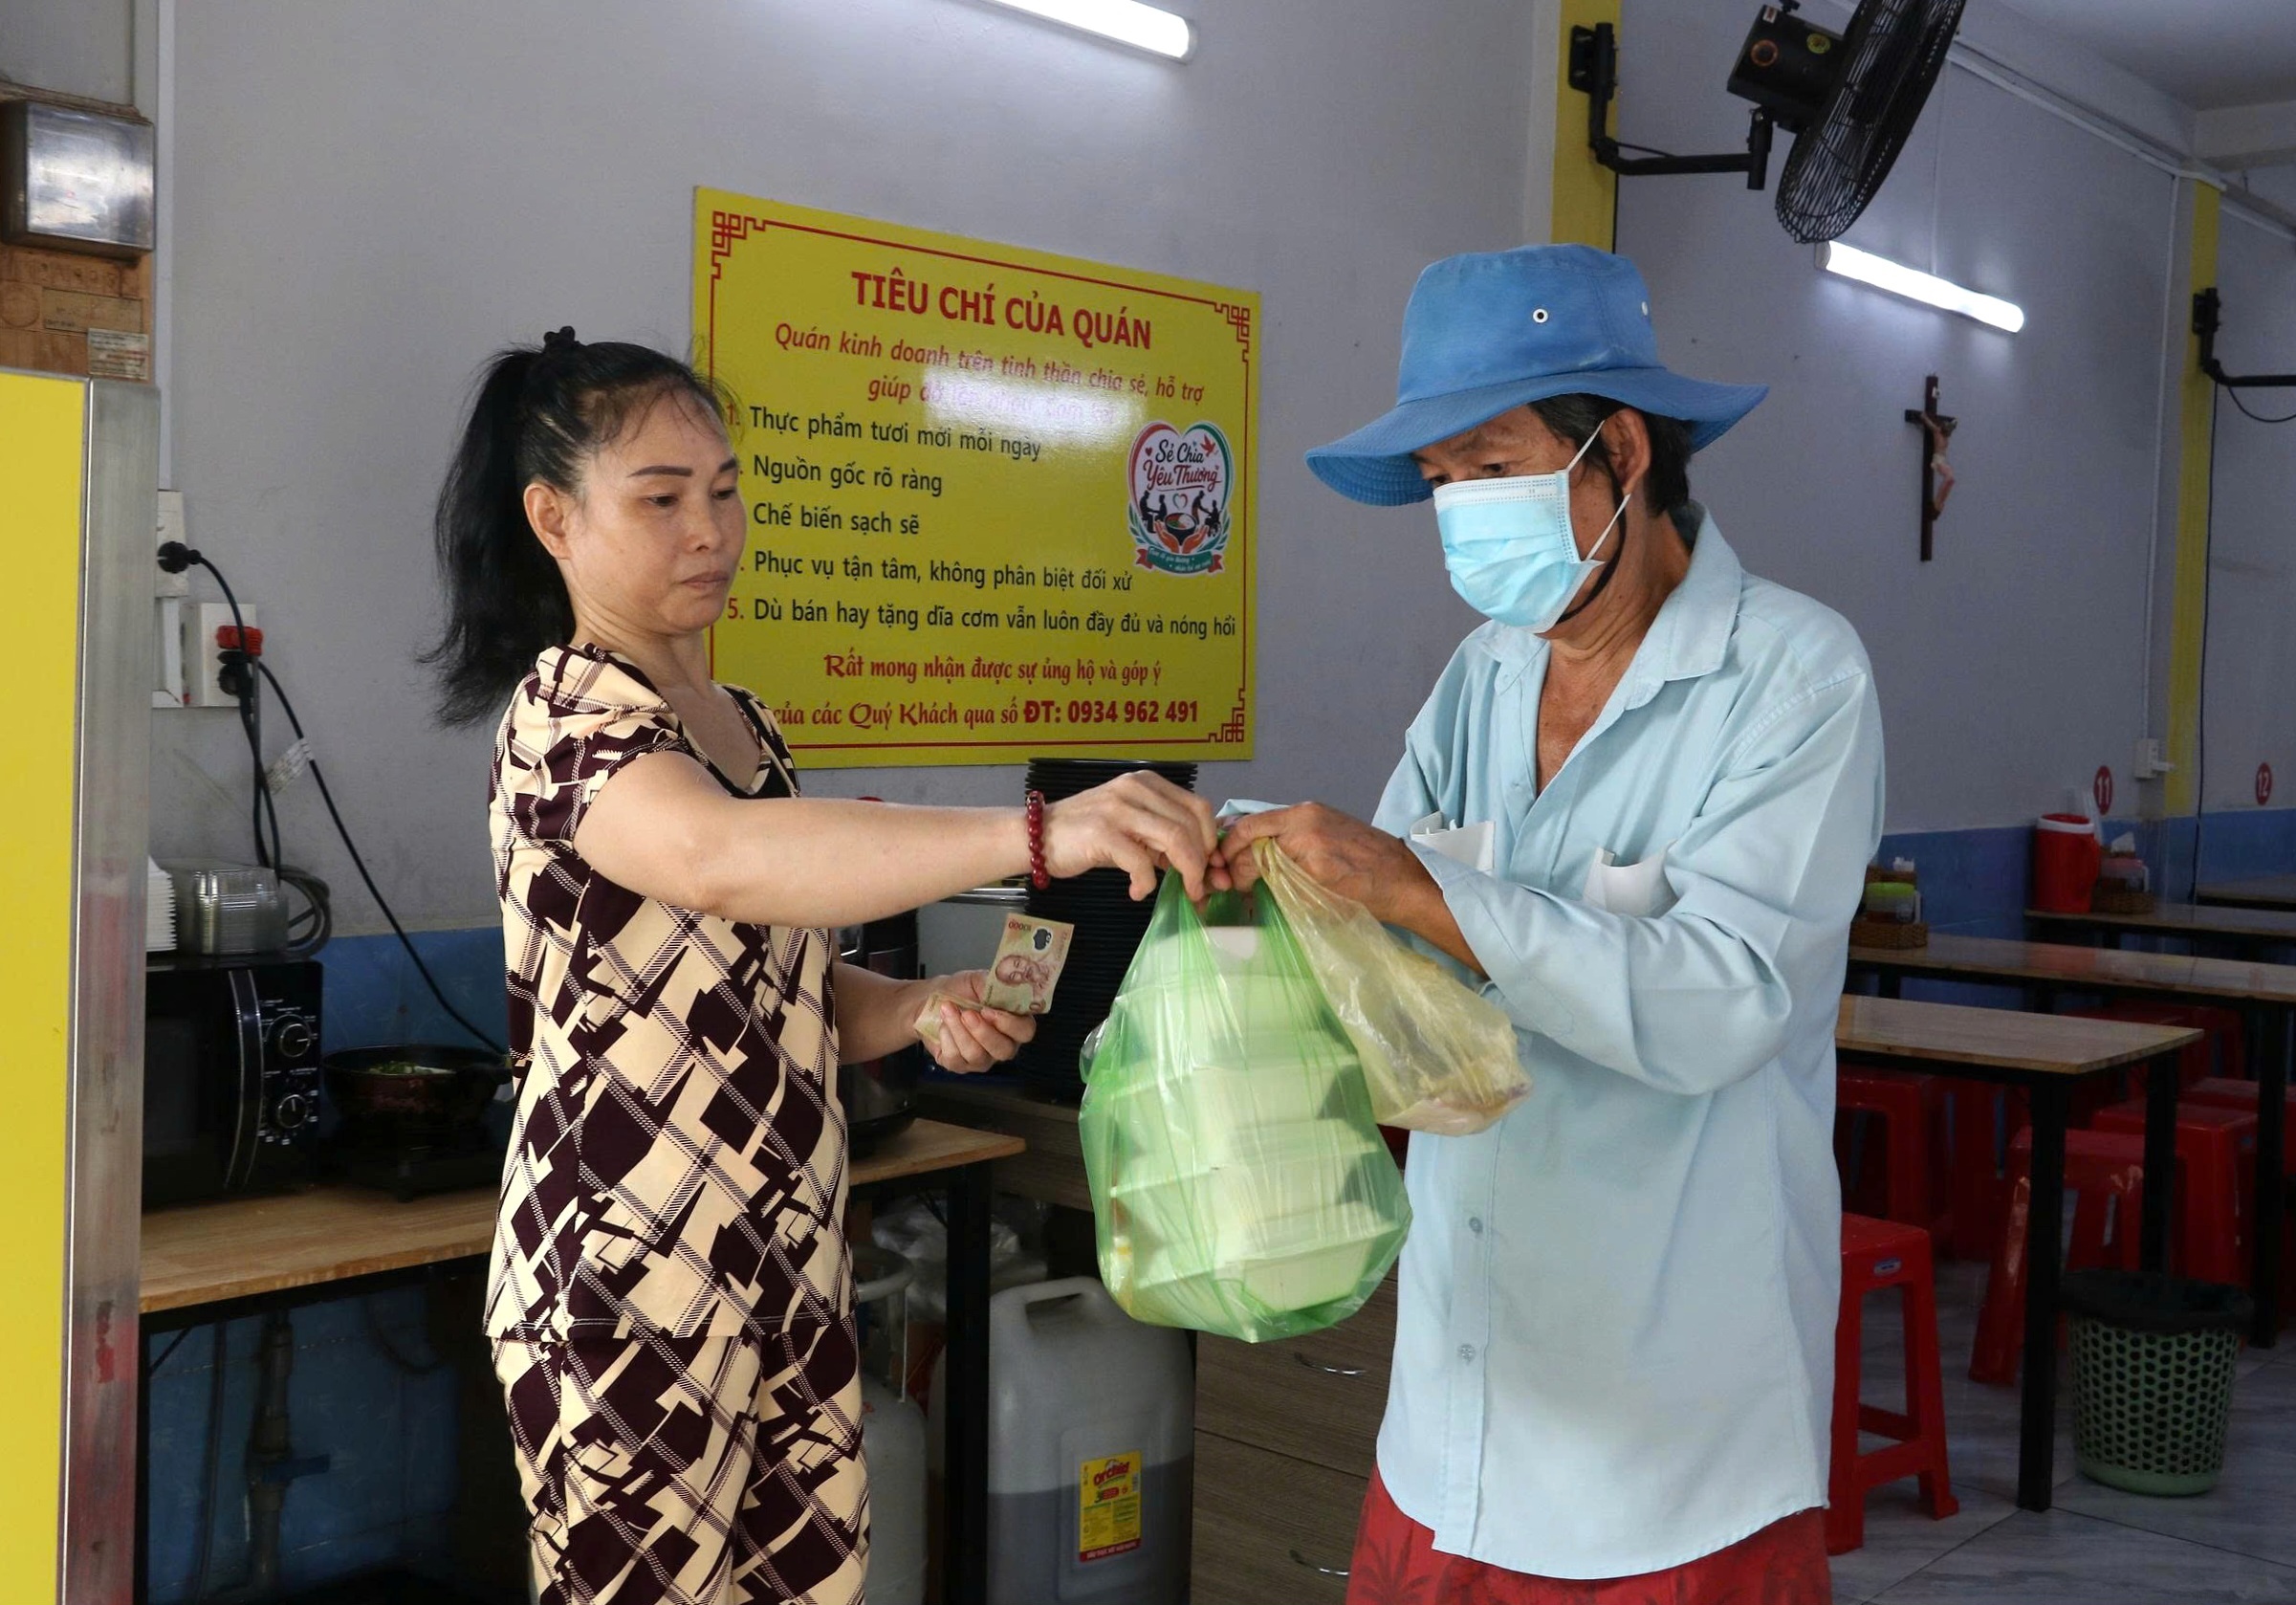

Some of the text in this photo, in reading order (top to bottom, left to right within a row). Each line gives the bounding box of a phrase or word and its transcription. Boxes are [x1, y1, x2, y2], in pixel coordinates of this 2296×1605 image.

[851, 267, 1150, 350] TIÊU CHÍ CỦA QUÁN
[776, 322, 830, 351] Quán
[840, 331, 882, 358] kinh
[890, 339, 949, 366] doanh
[958, 350, 993, 371] trên
[1089, 368, 1122, 391] chia
[1156, 376, 1175, 398] hỗ
[1182, 383, 1204, 406] trợ
[867, 375, 911, 405] giúp
[750, 406, 798, 434] Thực
[808, 412, 862, 439] phẩm
[870, 421, 908, 443] tươi
[918, 427, 951, 448] mới
[960, 428, 992, 451] mỗi
[1001, 436, 1040, 462] ngày
[1156, 439, 1204, 463] Sẻ Chia
[754, 454, 942, 497] Nguồn gốc rõ ràng
[1144, 459, 1173, 491] Yêu
[754, 502, 793, 526] Chế
[801, 505, 842, 529] biến
[851, 511, 891, 536] sạch
[755, 550, 1132, 591] Phục vụ tận tâm, không phân biệt đối xử
[728, 598, 744, 619] 5.
[754, 598, 782, 621] Dù
[792, 599, 827, 622] bán
[837, 601, 869, 629] hay
[877, 604, 918, 631] tặng
[961, 609, 998, 627] cơm
[1006, 605, 1036, 629] vẫn
[1044, 609, 1079, 630] luôn
[1086, 610, 1114, 637] đầy
[1121, 612, 1140, 632] đủ
[1147, 614, 1163, 633] và
[1170, 615, 1207, 640] nóng
[823, 647, 1162, 686] Rất mong nhận được sự ủng hộ và góp ý
[774, 696, 1198, 730] của các Quý Khách qua số ĐT: 0934 962 491
[2097, 776, 2110, 805] 11
[2258, 772, 2269, 797] 12
